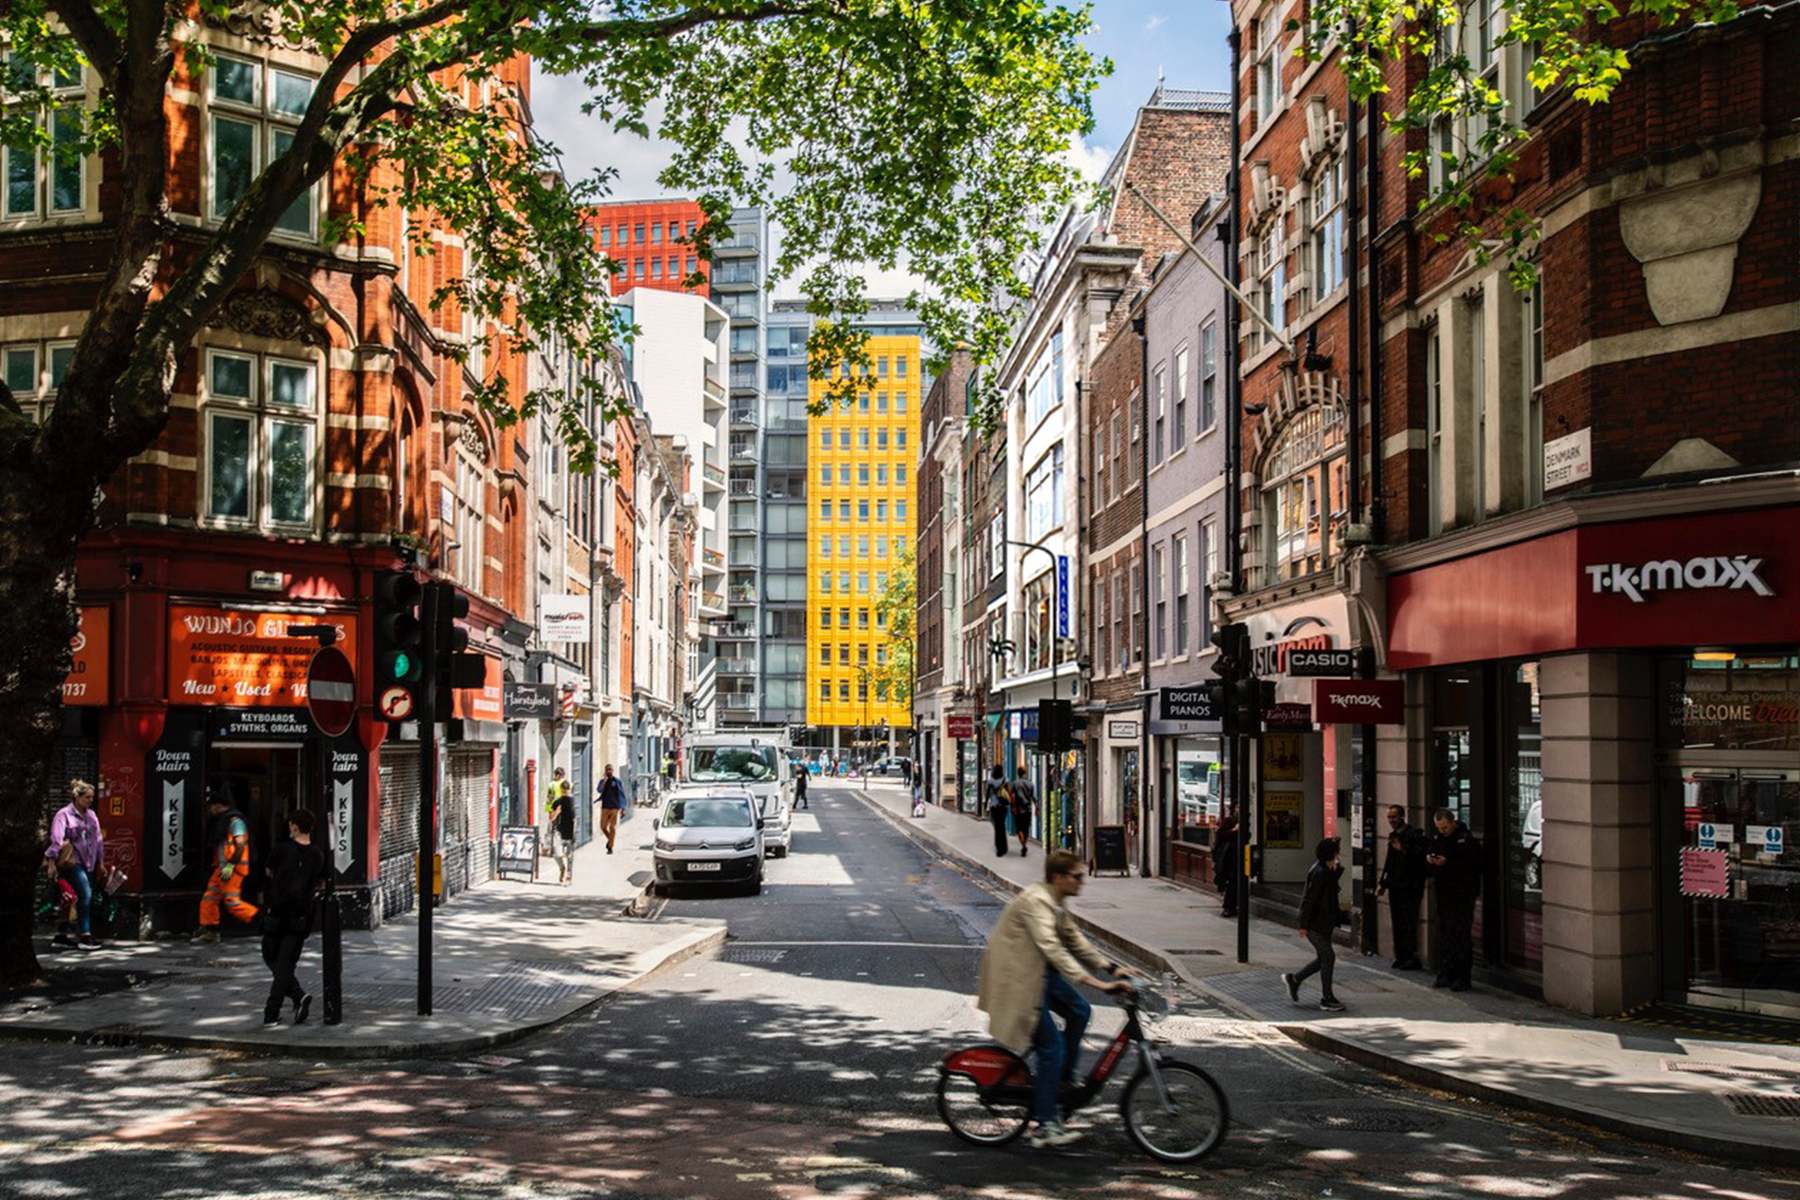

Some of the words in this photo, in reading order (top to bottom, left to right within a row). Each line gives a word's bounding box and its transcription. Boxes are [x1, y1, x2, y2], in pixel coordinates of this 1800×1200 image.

[1546, 445, 1581, 468] DENMARK
[1546, 464, 1572, 484] STREET
[184, 615, 257, 636] WUNJO
[191, 643, 237, 653] ACOUSTIC
[1292, 653, 1350, 667] CASIO
[182, 680, 217, 694] New
[233, 681, 272, 697] Used
[1169, 692, 1211, 703] DIGITAL
[1170, 705, 1211, 716] PIANOS
[271, 724, 308, 734] ORGANS
[156, 749, 190, 761] Down
[156, 760, 190, 772] stairs
[333, 761, 358, 772] tairs
[168, 799, 178, 857] KEYS
[338, 798, 347, 851] KEYS
